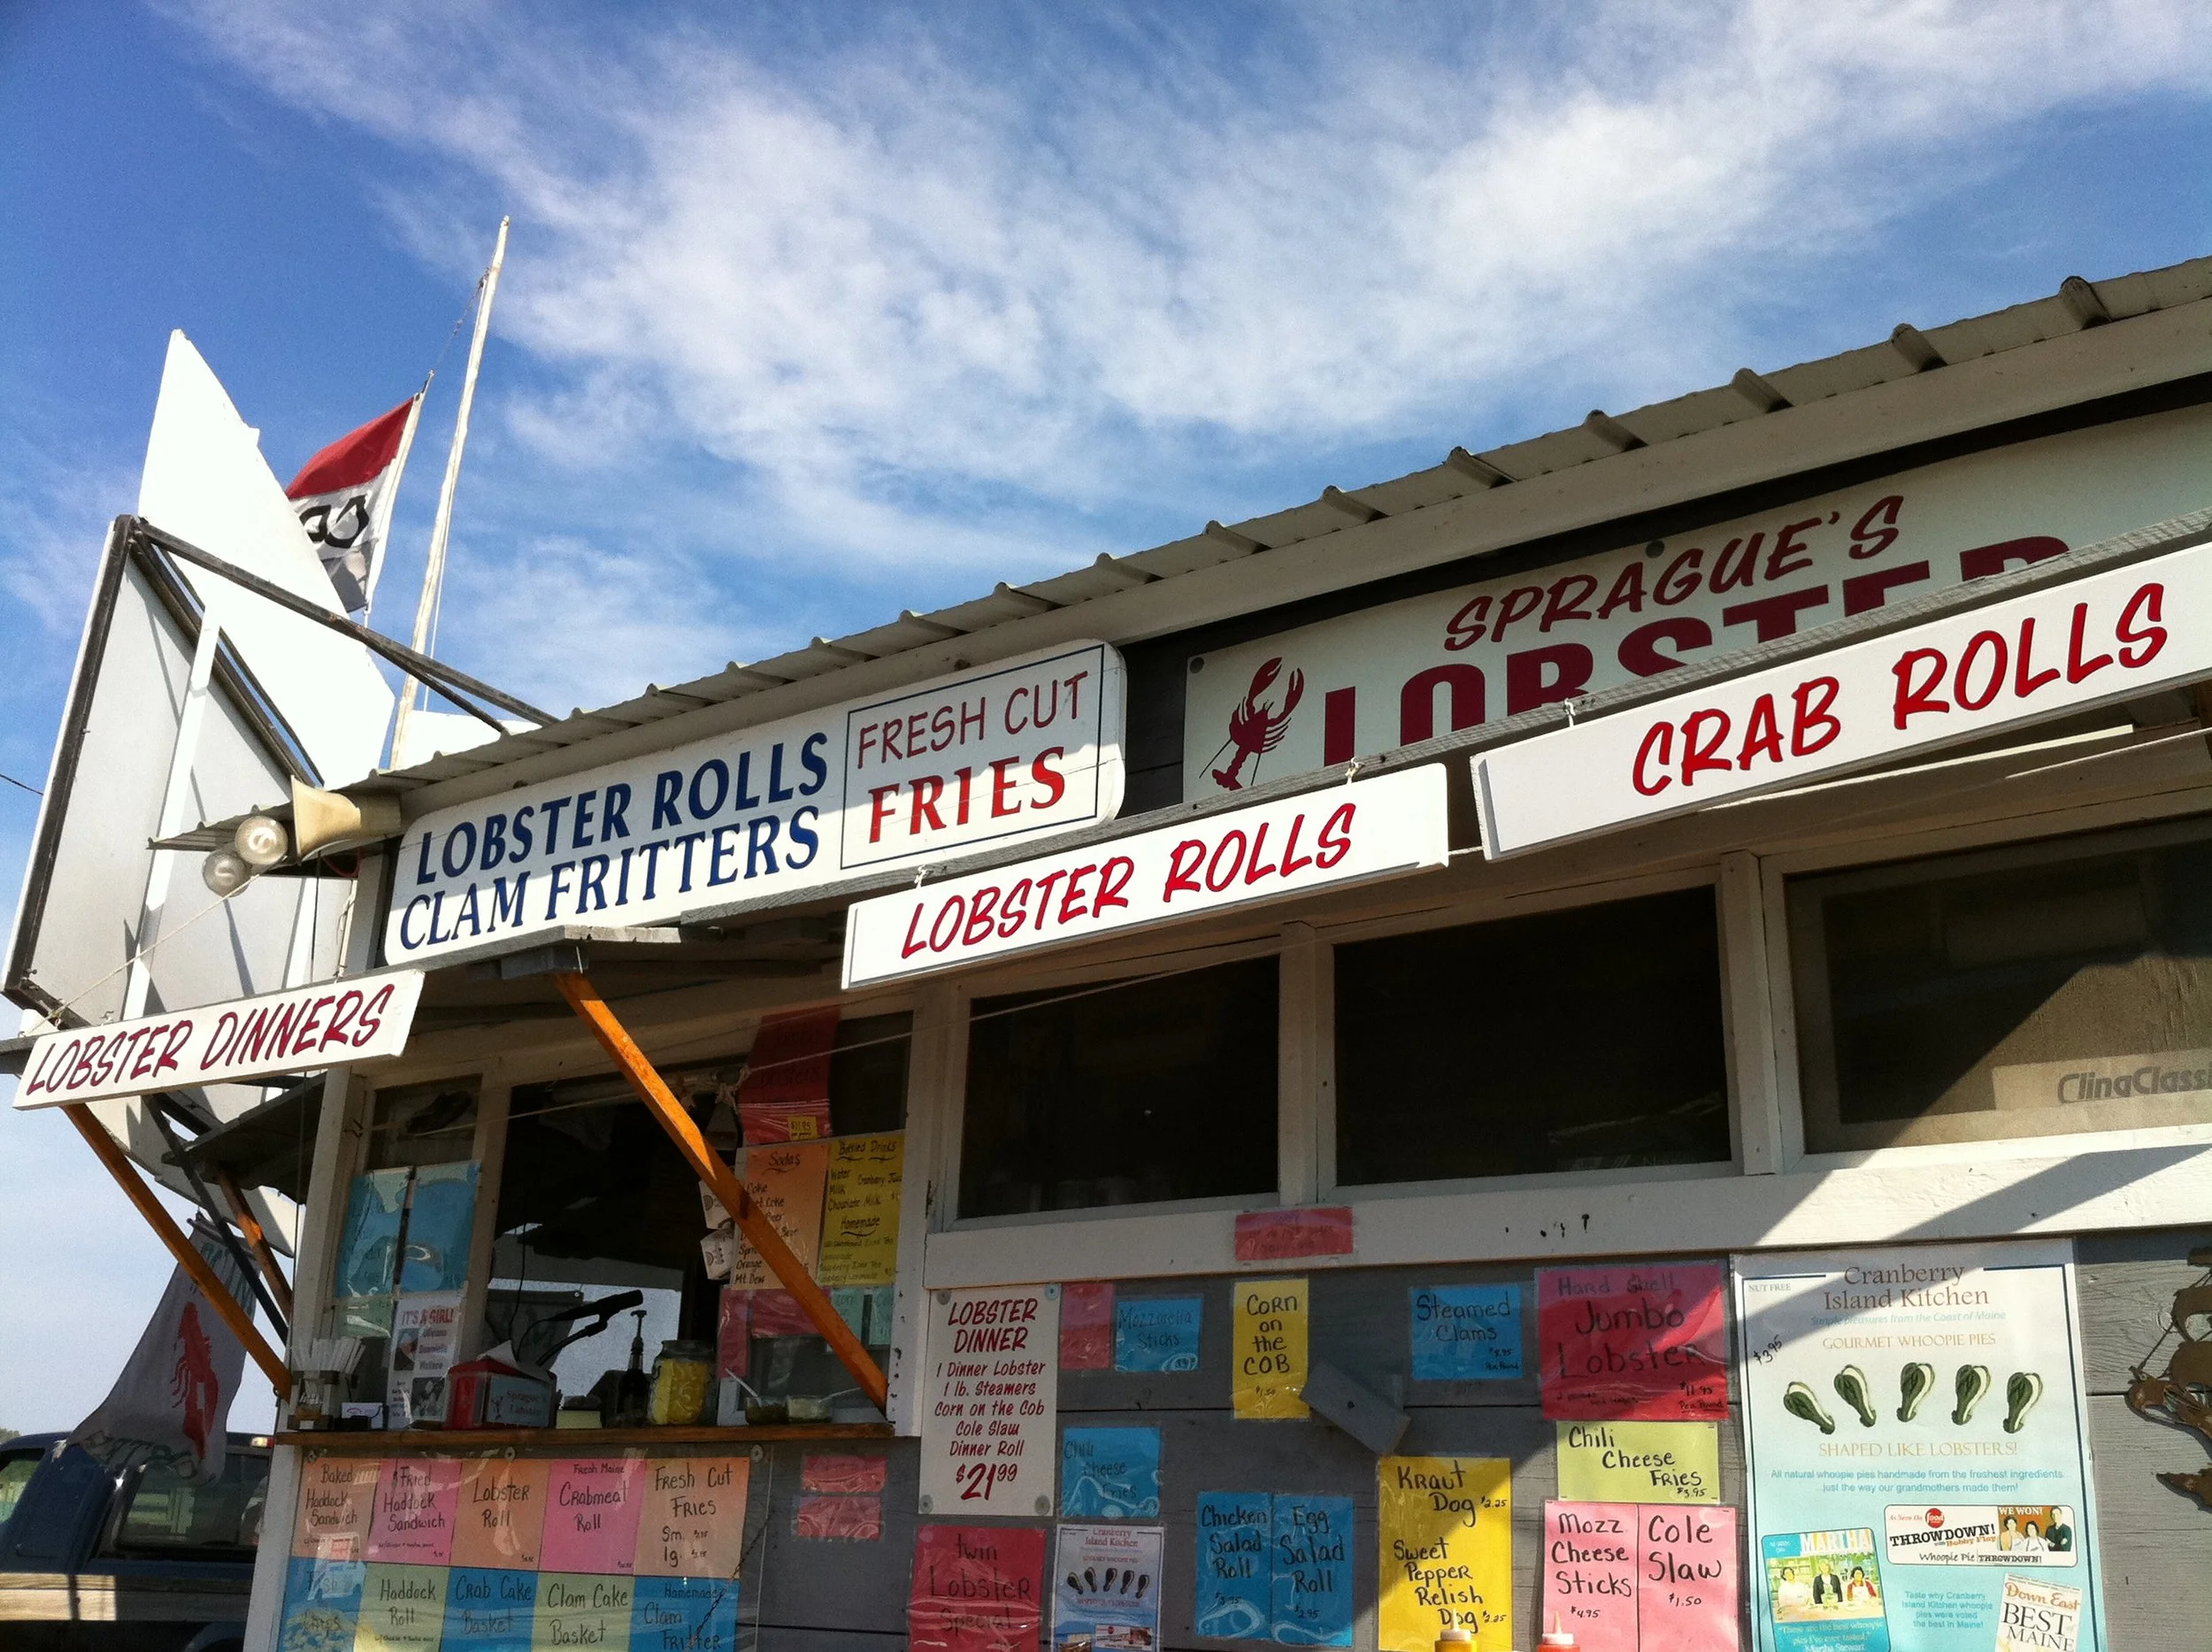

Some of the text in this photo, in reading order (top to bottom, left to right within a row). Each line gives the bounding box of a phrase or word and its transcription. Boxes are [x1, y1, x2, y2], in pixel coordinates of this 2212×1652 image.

[1443, 496, 1905, 650] SPRAGUE'S
[1323, 535, 2070, 767] LOBST
[1632, 581, 2167, 796] CRAB ROLLS
[857, 671, 1089, 769] FRESH CUT
[869, 745, 1065, 844] FRIES
[418, 732, 828, 885] LOBSTER ROLLS
[400, 805, 820, 950] CLAM FRITTERS
[901, 803, 1357, 959] LOBSTER ROLLS
[27, 984, 395, 1096] LOBSTER DINNERS
[1558, 1272, 1678, 1296] Hard Shell
[1747, 1282, 1792, 1293] NUT FREE
[1844, 1264, 1965, 1287] Cranberry
[1246, 1295, 1298, 1316] Corn
[1417, 1289, 1511, 1321] Steamed
[1824, 1287, 1990, 1311] Island Kitchen
[949, 1298, 1038, 1326] LOBSTER
[1574, 1298, 1686, 1335] Jumbo
[1890, 1313, 1914, 1324] from
[1916, 1312, 1932, 1323] the
[1932, 1312, 1961, 1322] Coast
[1963, 1311, 1974, 1321] of
[1975, 1310, 2007, 1320] Maine
[1259, 1318, 1282, 1333] on
[1435, 1325, 1498, 1342] Clams
[954, 1326, 1028, 1353] DINNER
[1252, 1334, 1286, 1353] the
[1822, 1333, 1996, 1349] GOURMET WHOOPIE PIES
[947, 1362, 988, 1377] Dinner
[994, 1360, 1046, 1376] Lobster
[1243, 1354, 1290, 1376] COB
[1556, 1342, 1706, 1380] Lobster
[955, 1381, 969, 1396] lb.
[975, 1381, 1035, 1396] Steamers
[934, 1399, 1045, 1417] Corn on the Cob
[956, 1420, 1019, 1436] Cole Slaw
[1569, 1425, 1615, 1448] Chili
[949, 1440, 1025, 1456] Dinner Roll
[1601, 1449, 1676, 1469] Cheese
[1818, 1441, 2017, 1457] SHAPED LIKE LOBSTERS!
[320, 1464, 352, 1484] Baked
[400, 1464, 431, 1487] Fried
[655, 1463, 733, 1491] Fresh Cut
[1084, 1463, 1126, 1477] Cheese
[1397, 1460, 1466, 1489] Kraut
[1649, 1469, 1702, 1487] Fries
[1770, 1469, 2062, 1481] All natural whoopie pies handmade from the freshest ingredients
[305, 1487, 350, 1509] Haddock
[472, 1477, 530, 1503] Lobster
[559, 1481, 628, 1506] Crabmeat
[1840, 1482, 1855, 1492] the
[1856, 1485, 1877, 1494] way
[1895, 1482, 1960, 1494] grandmothers
[1962, 1482, 1989, 1492] made
[1992, 1482, 2018, 1492] them!
[383, 1492, 437, 1512] Haddock
[671, 1495, 717, 1518] Fries
[1429, 1492, 1476, 1527] Dog
[388, 1513, 445, 1533] Sandwich
[482, 1510, 511, 1529] Roll
[574, 1513, 602, 1533] Roll
[1202, 1505, 1269, 1527] Chicken
[1293, 1504, 1330, 1534] Egg
[1648, 1515, 1713, 1543] Cole
[1890, 1523, 1996, 1548] THROWDOWN!
[1209, 1530, 1262, 1555] Salad
[1279, 1533, 1345, 1565] Salad
[1394, 1537, 1449, 1561] Sweet
[1551, 1541, 1629, 1564] Cheese
[1213, 1557, 1251, 1579] Roll
[1648, 1551, 1722, 1583] Slaw
[1919, 1551, 2042, 1564] Whoopie Pie THROWDOWN!
[930, 1564, 1033, 1602] Lobster
[1294, 1568, 1333, 1593] Roll
[1404, 1562, 1473, 1588] Pepper
[1555, 1570, 1632, 1597] Sticks
[380, 1579, 436, 1602] Haddock
[455, 1575, 532, 1602] Crab Cake
[547, 1583, 628, 1609] Clam Cake
[1415, 1585, 1483, 1606] Relish
[1669, 1593, 1701, 1607] $1.50
[2004, 1582, 2047, 1607] Down
[2050, 1589, 2081, 1612] East
[389, 1606, 415, 1625] Roll
[644, 1601, 683, 1625] Clam
[1571, 1606, 1601, 1618] $4.95
[1928, 1601, 1957, 1610] Kitchen
[1959, 1601, 1993, 1611] whoopie
[461, 1606, 514, 1635] Basket
[2003, 1602, 2075, 1636] BEST
[549, 1618, 606, 1646] Basket
[2006, 1627, 2075, 1652] MAINE
